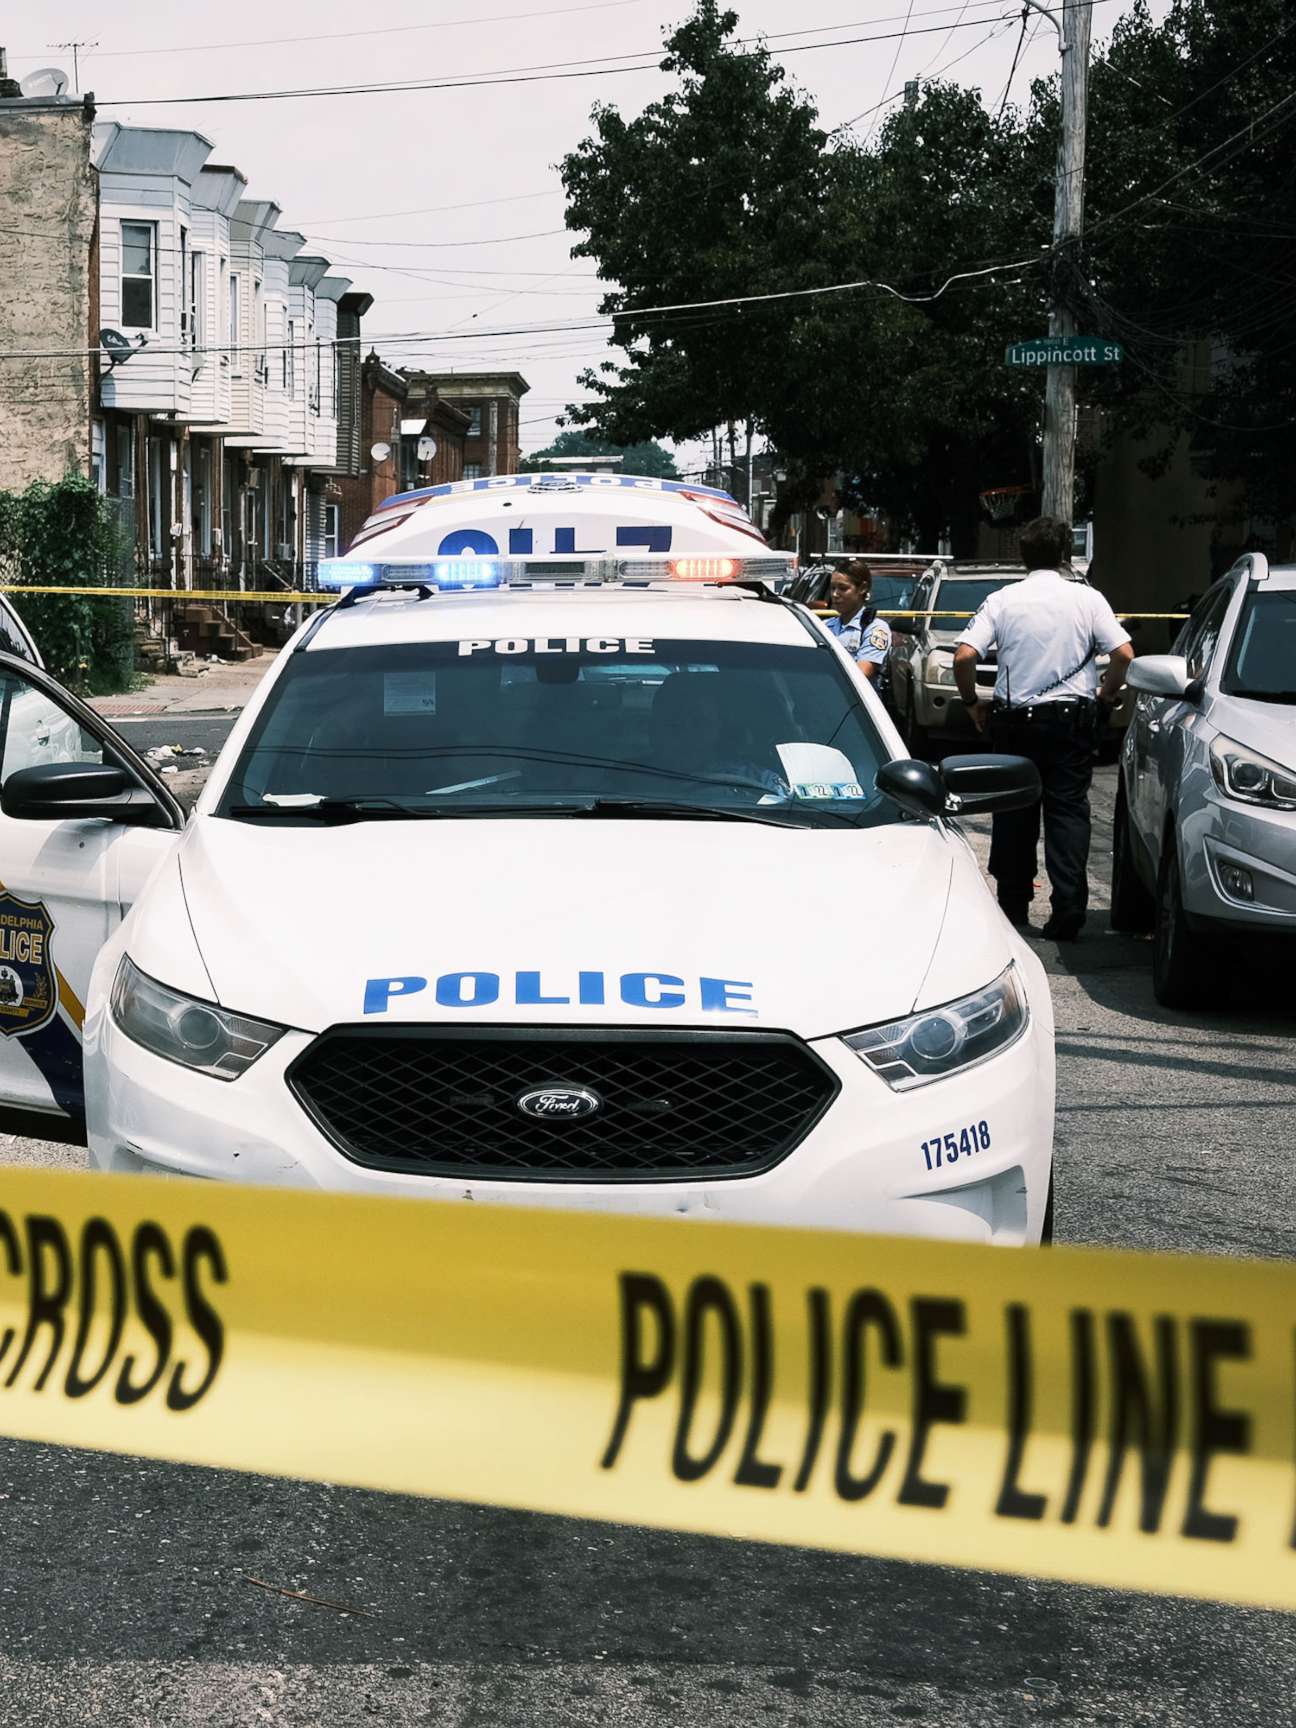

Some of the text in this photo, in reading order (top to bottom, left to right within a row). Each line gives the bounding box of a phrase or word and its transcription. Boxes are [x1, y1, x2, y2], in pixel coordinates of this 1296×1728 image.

[1012, 346, 1120, 366] Lippincott St
[457, 638, 656, 657] POLICE
[363, 971, 759, 1019] POLICE
[535, 1094, 579, 1112] Ford
[921, 1120, 991, 1170] 175418
[598, 1269, 968, 1510] POLICE
[994, 1301, 1252, 1543] LINE
